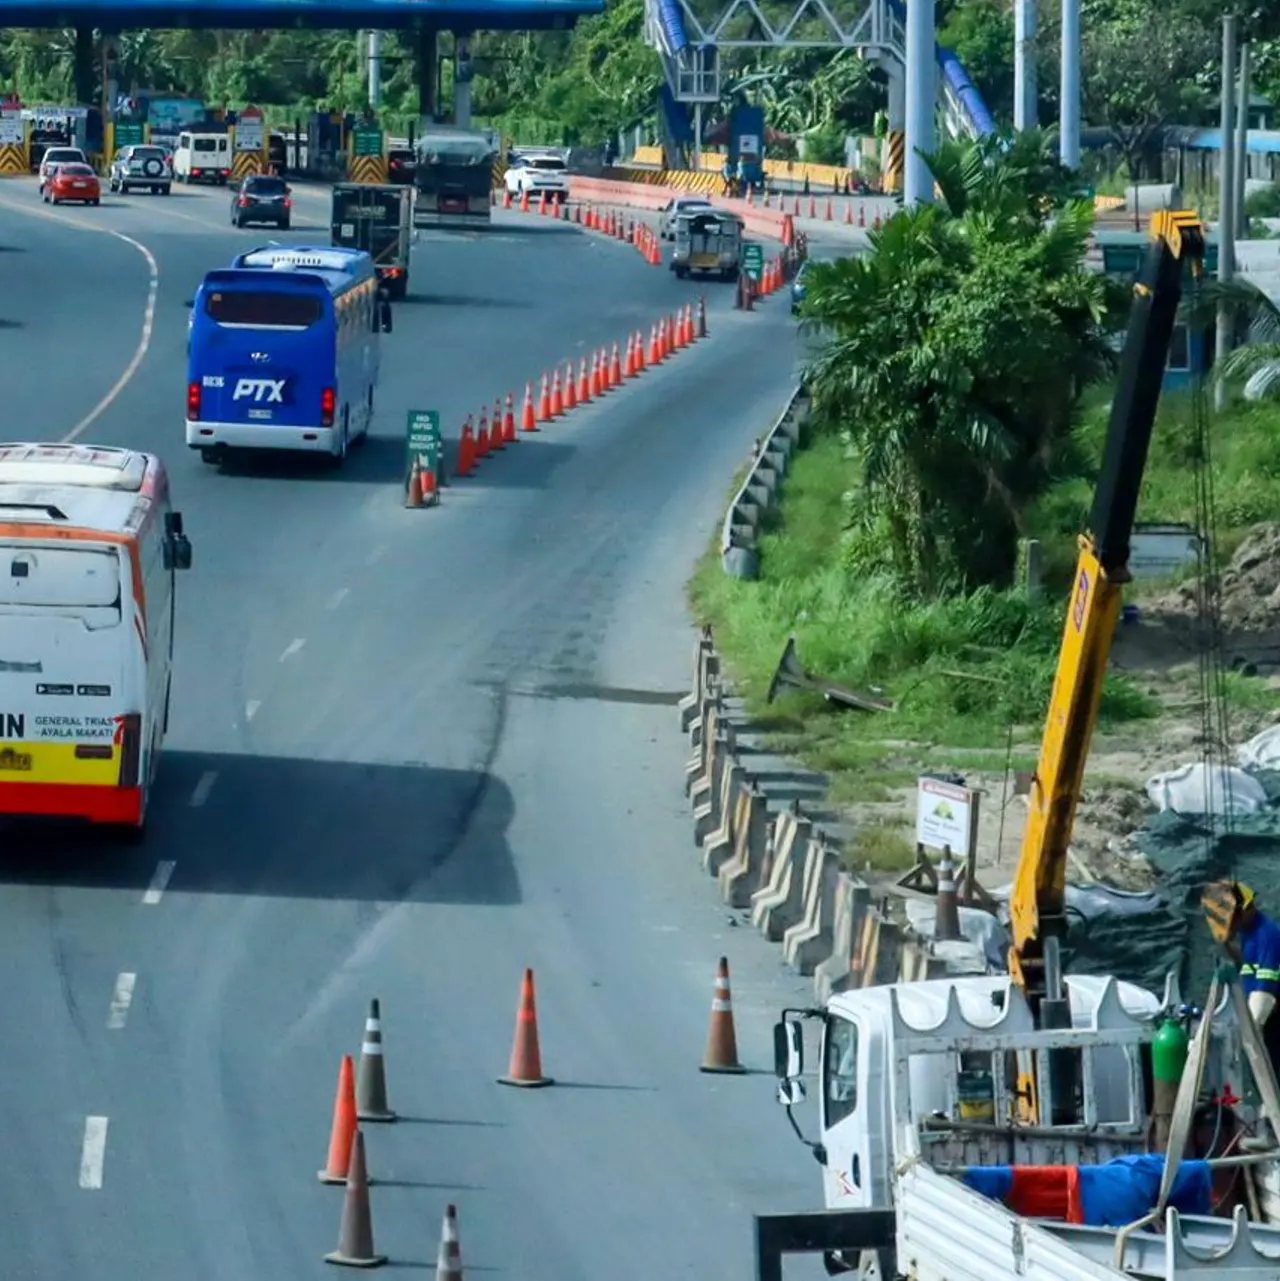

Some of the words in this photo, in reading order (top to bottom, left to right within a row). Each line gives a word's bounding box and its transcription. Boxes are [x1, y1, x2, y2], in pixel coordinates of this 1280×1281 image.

[233, 378, 286, 403] PTX
[35, 716, 82, 726] GENERAL
[75, 728, 113, 739] MAKATI
